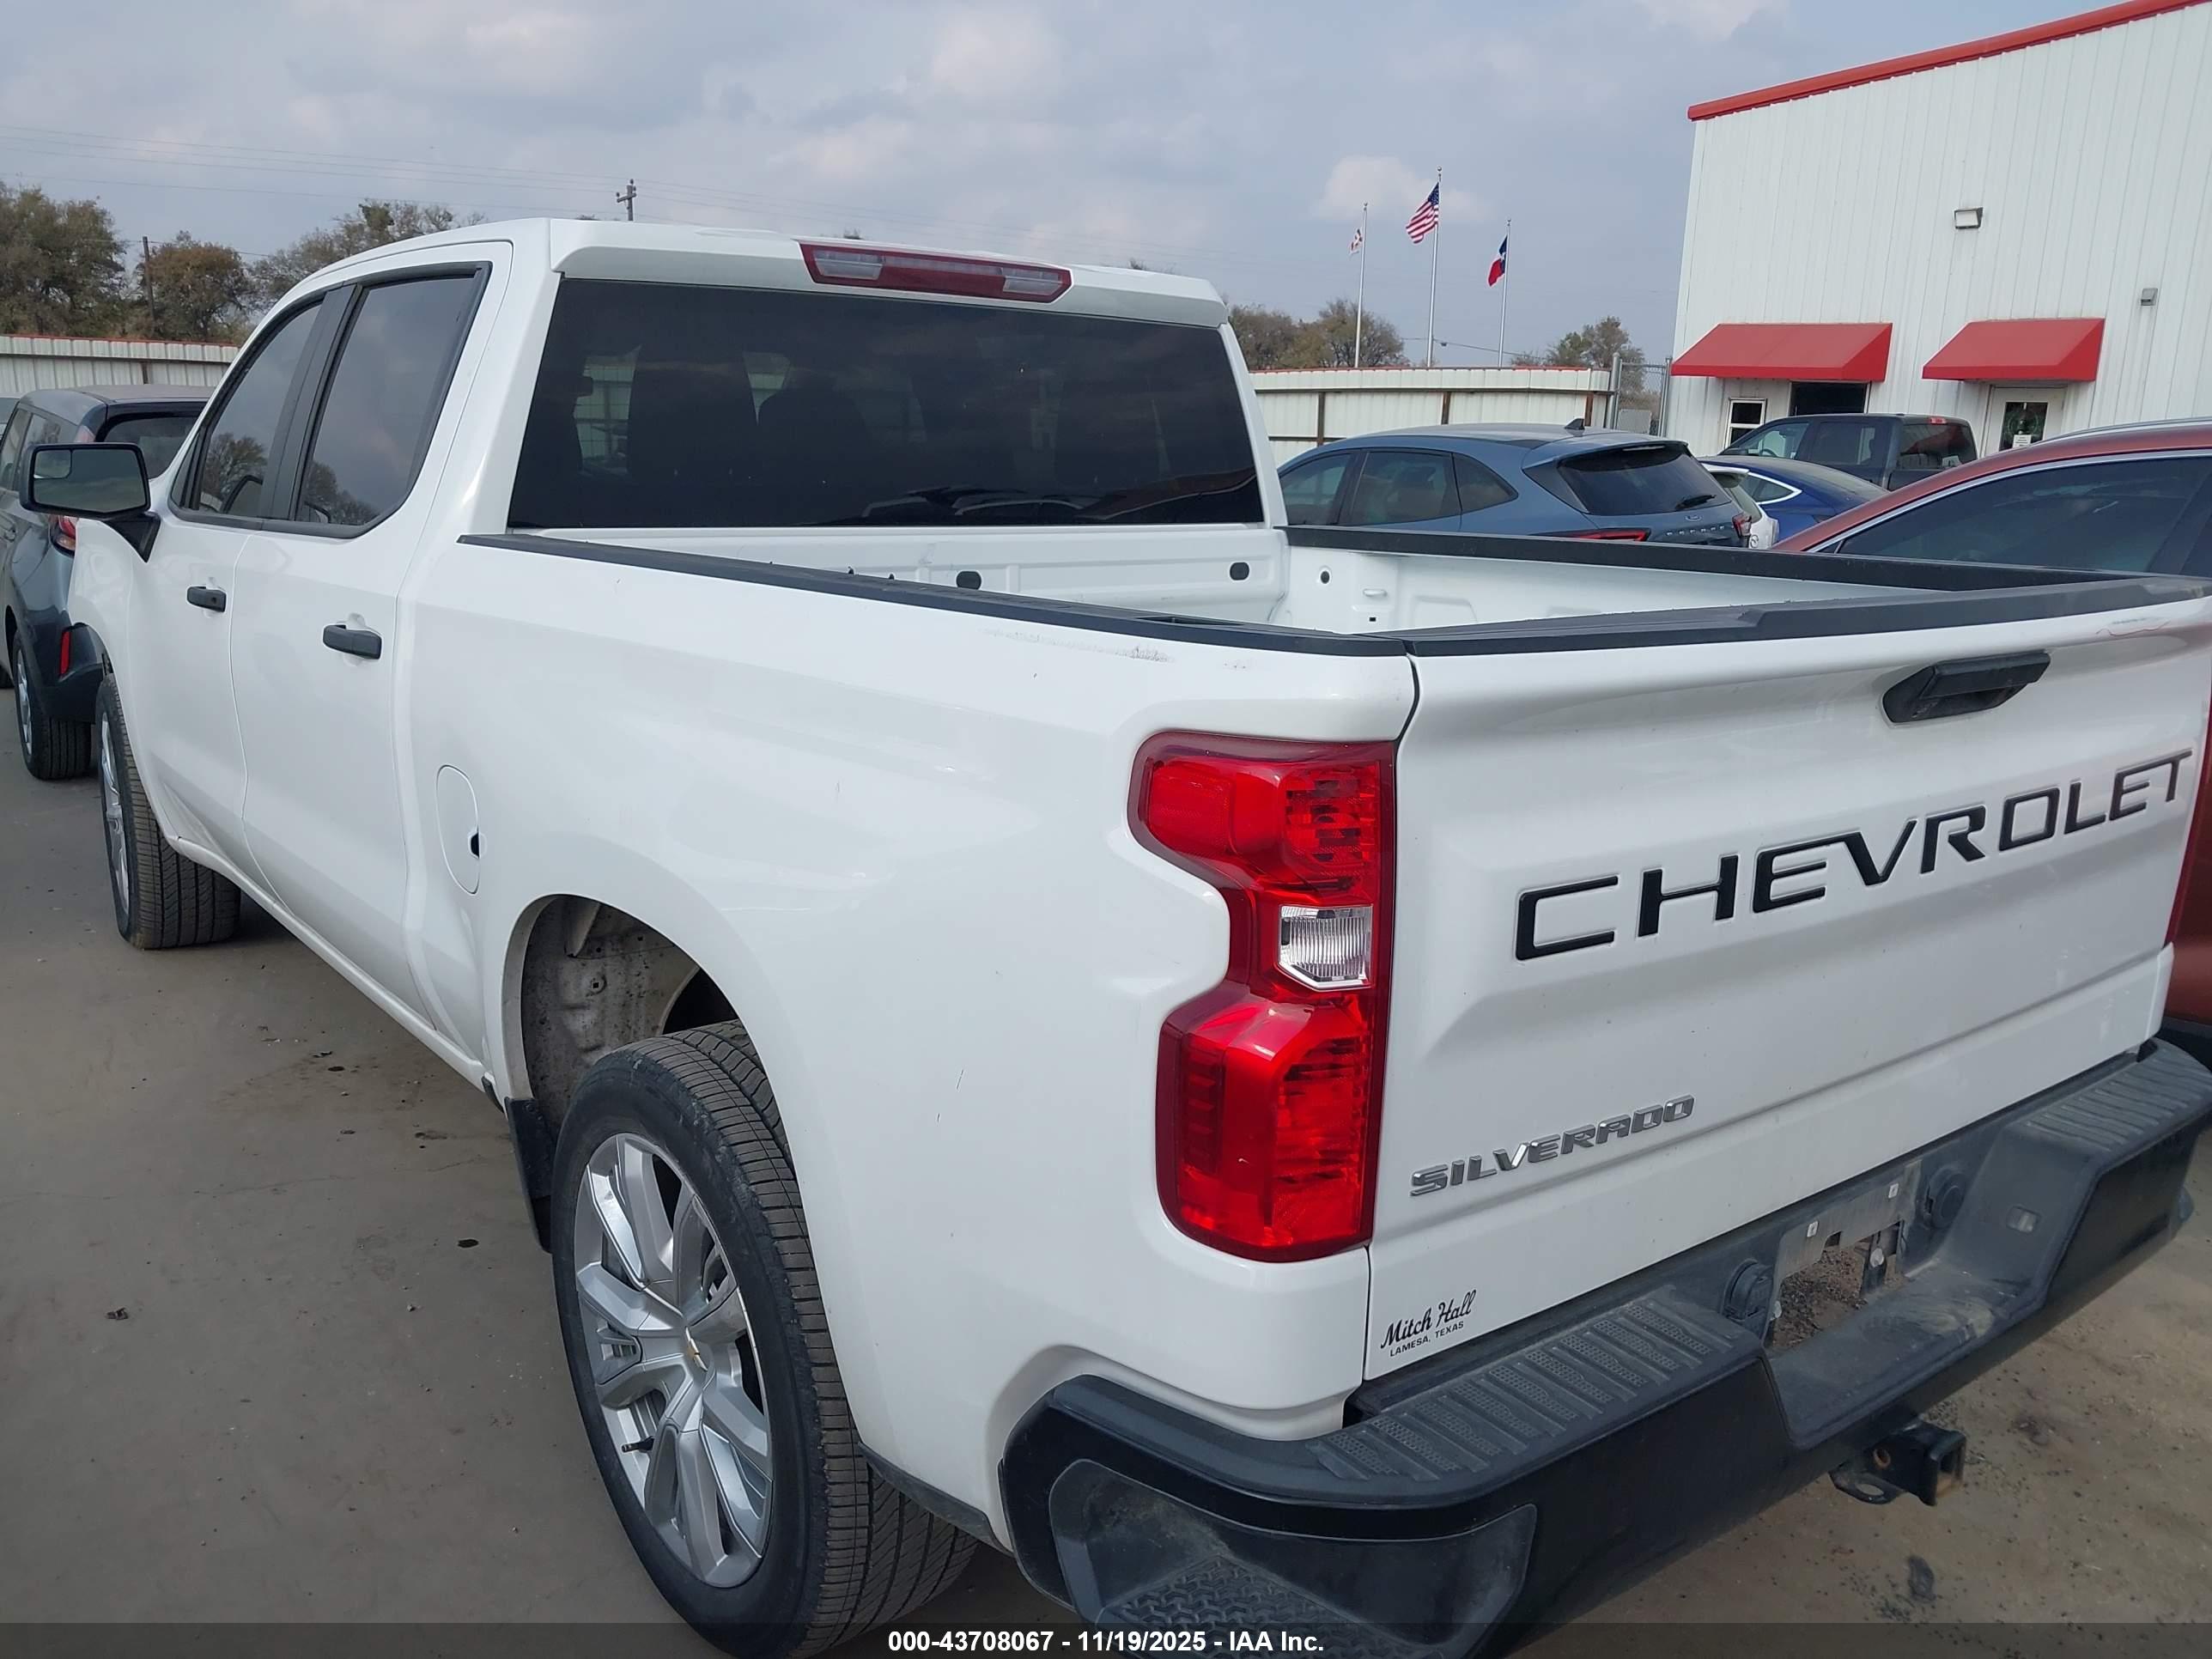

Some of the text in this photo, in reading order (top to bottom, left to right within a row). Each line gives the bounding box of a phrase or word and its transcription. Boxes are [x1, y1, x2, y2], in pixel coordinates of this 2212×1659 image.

[1514, 748, 2192, 961] CHEVROLET
[1410, 1094, 1695, 1196] SILVERADO
[1380, 1289, 1477, 1349] Mitch Hall
[1389, 1321, 1464, 1358] LAMESA, TEXAS
